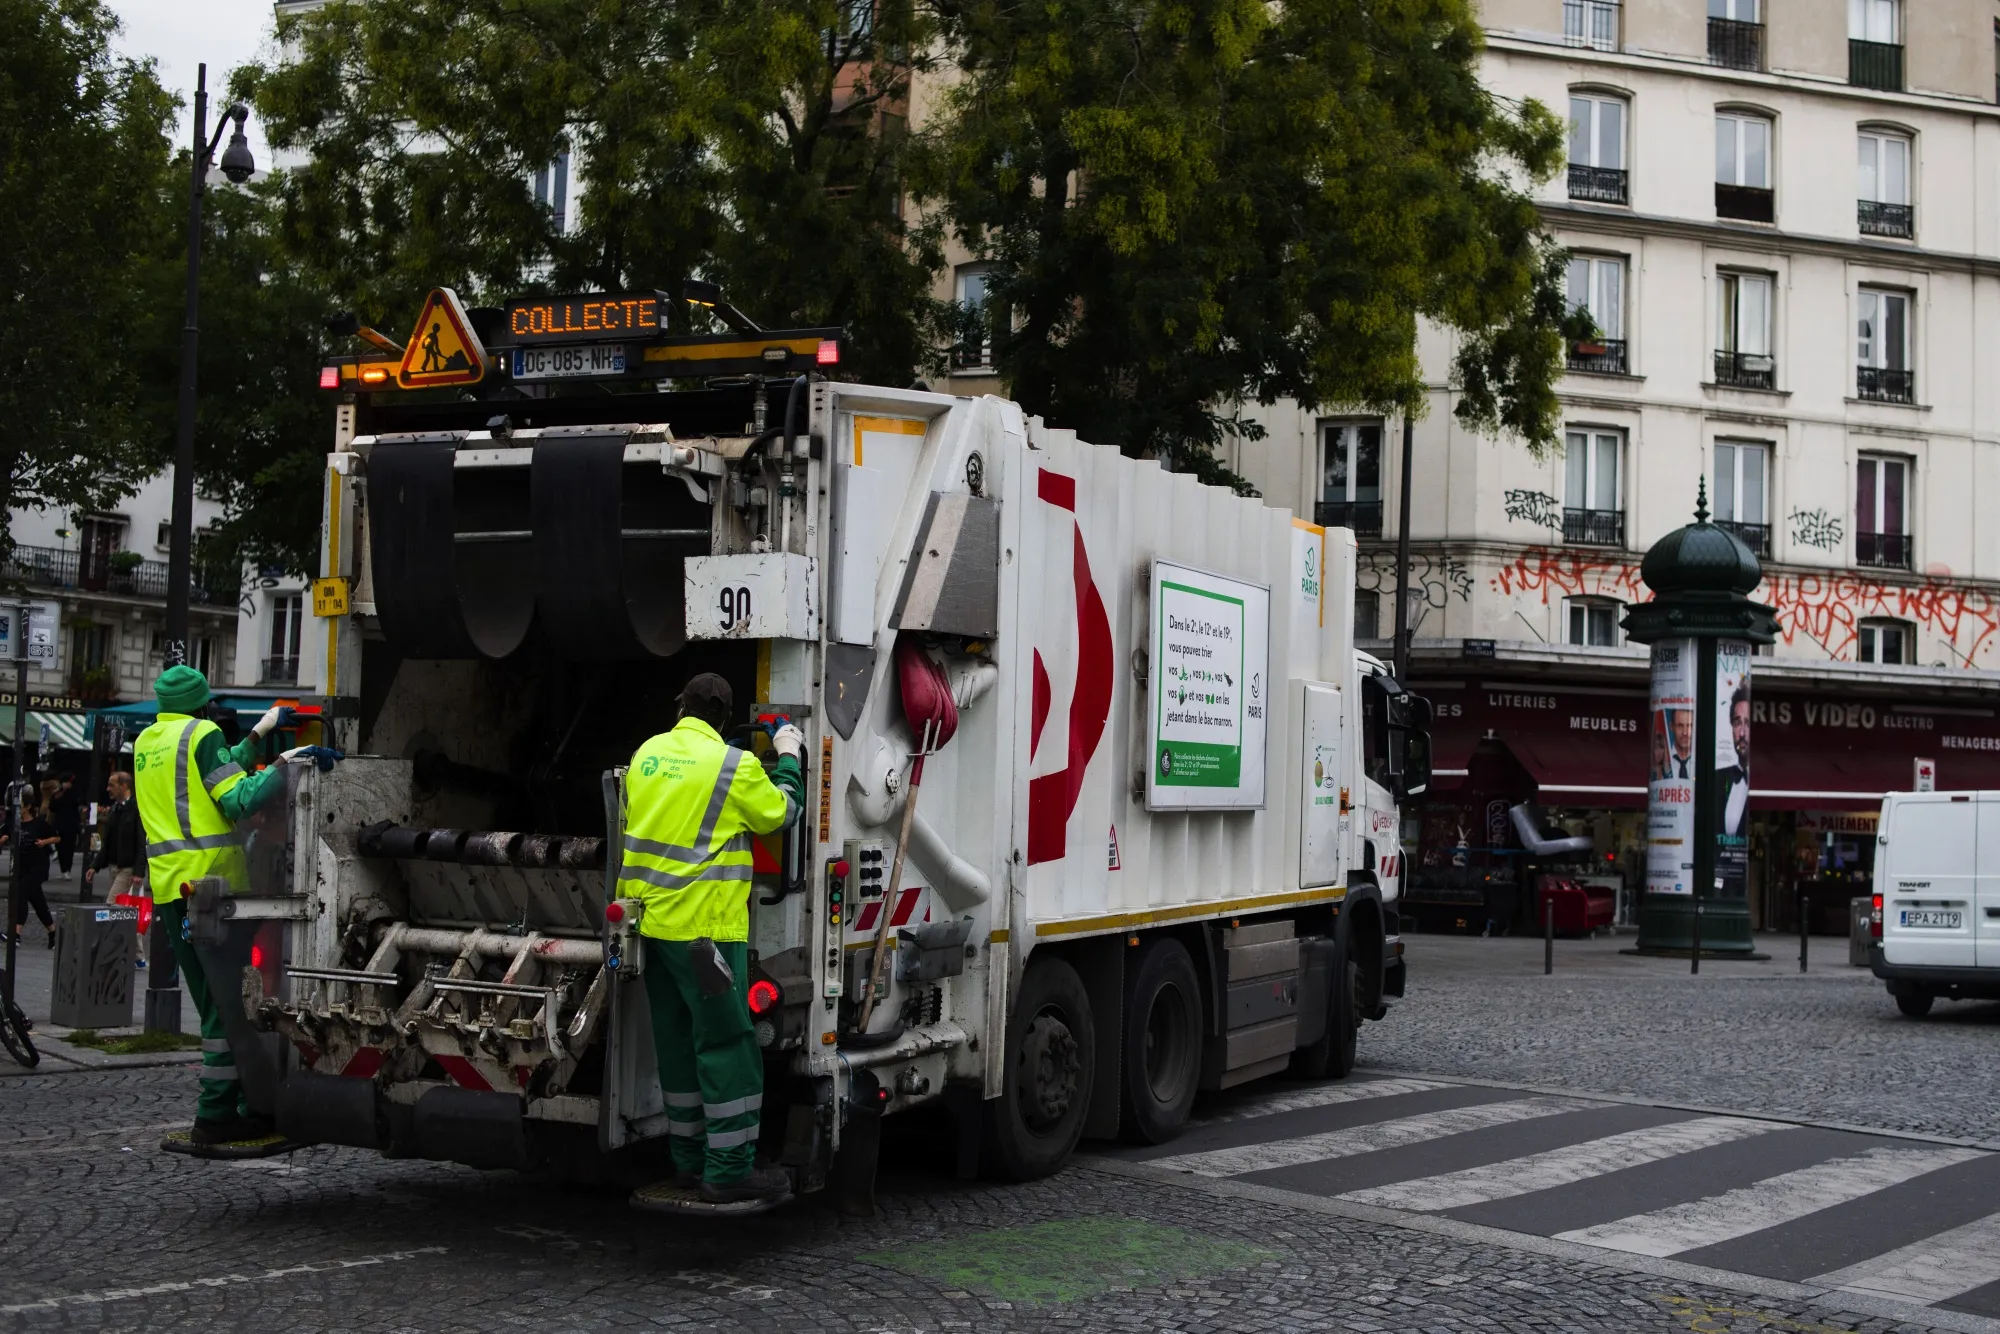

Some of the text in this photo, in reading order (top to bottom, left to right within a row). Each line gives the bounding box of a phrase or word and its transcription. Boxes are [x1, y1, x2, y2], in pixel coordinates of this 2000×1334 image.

[512, 300, 656, 334] COLLECTE
[525, 348, 612, 373] DG-085-NH
[614, 357, 624, 369] 92
[1302, 577, 1318, 597] PARIS
[720, 586, 751, 631] 90
[1169, 614, 1184, 631] Dans
[1184, 617, 1190, 632] le
[1198, 620, 1204, 634] le
[1212, 627, 1218, 638] et
[1218, 624, 1223, 638] le
[1168, 643, 1212, 659] vous pouvez trier
[1168, 666, 1222, 682] vos vos vos
[30, 695, 83, 709] PARIS
[1168, 689, 1230, 705] vos et vos en les
[1489, 693, 1557, 709] LITERIES
[1166, 708, 1232, 727] jetant dans le bac marron.
[1248, 706, 1262, 719] PARIS
[1752, 700, 1792, 724] RIS
[1569, 716, 1638, 732] MEUBLES
[1883, 715, 1935, 730] ELECTRO
[1941, 735, 2000, 751] MENAGERS
[662, 772, 684, 780] Paris
[1658, 785, 1691, 803] APRÈS
[1907, 912, 1959, 925] EPA 2TT9
